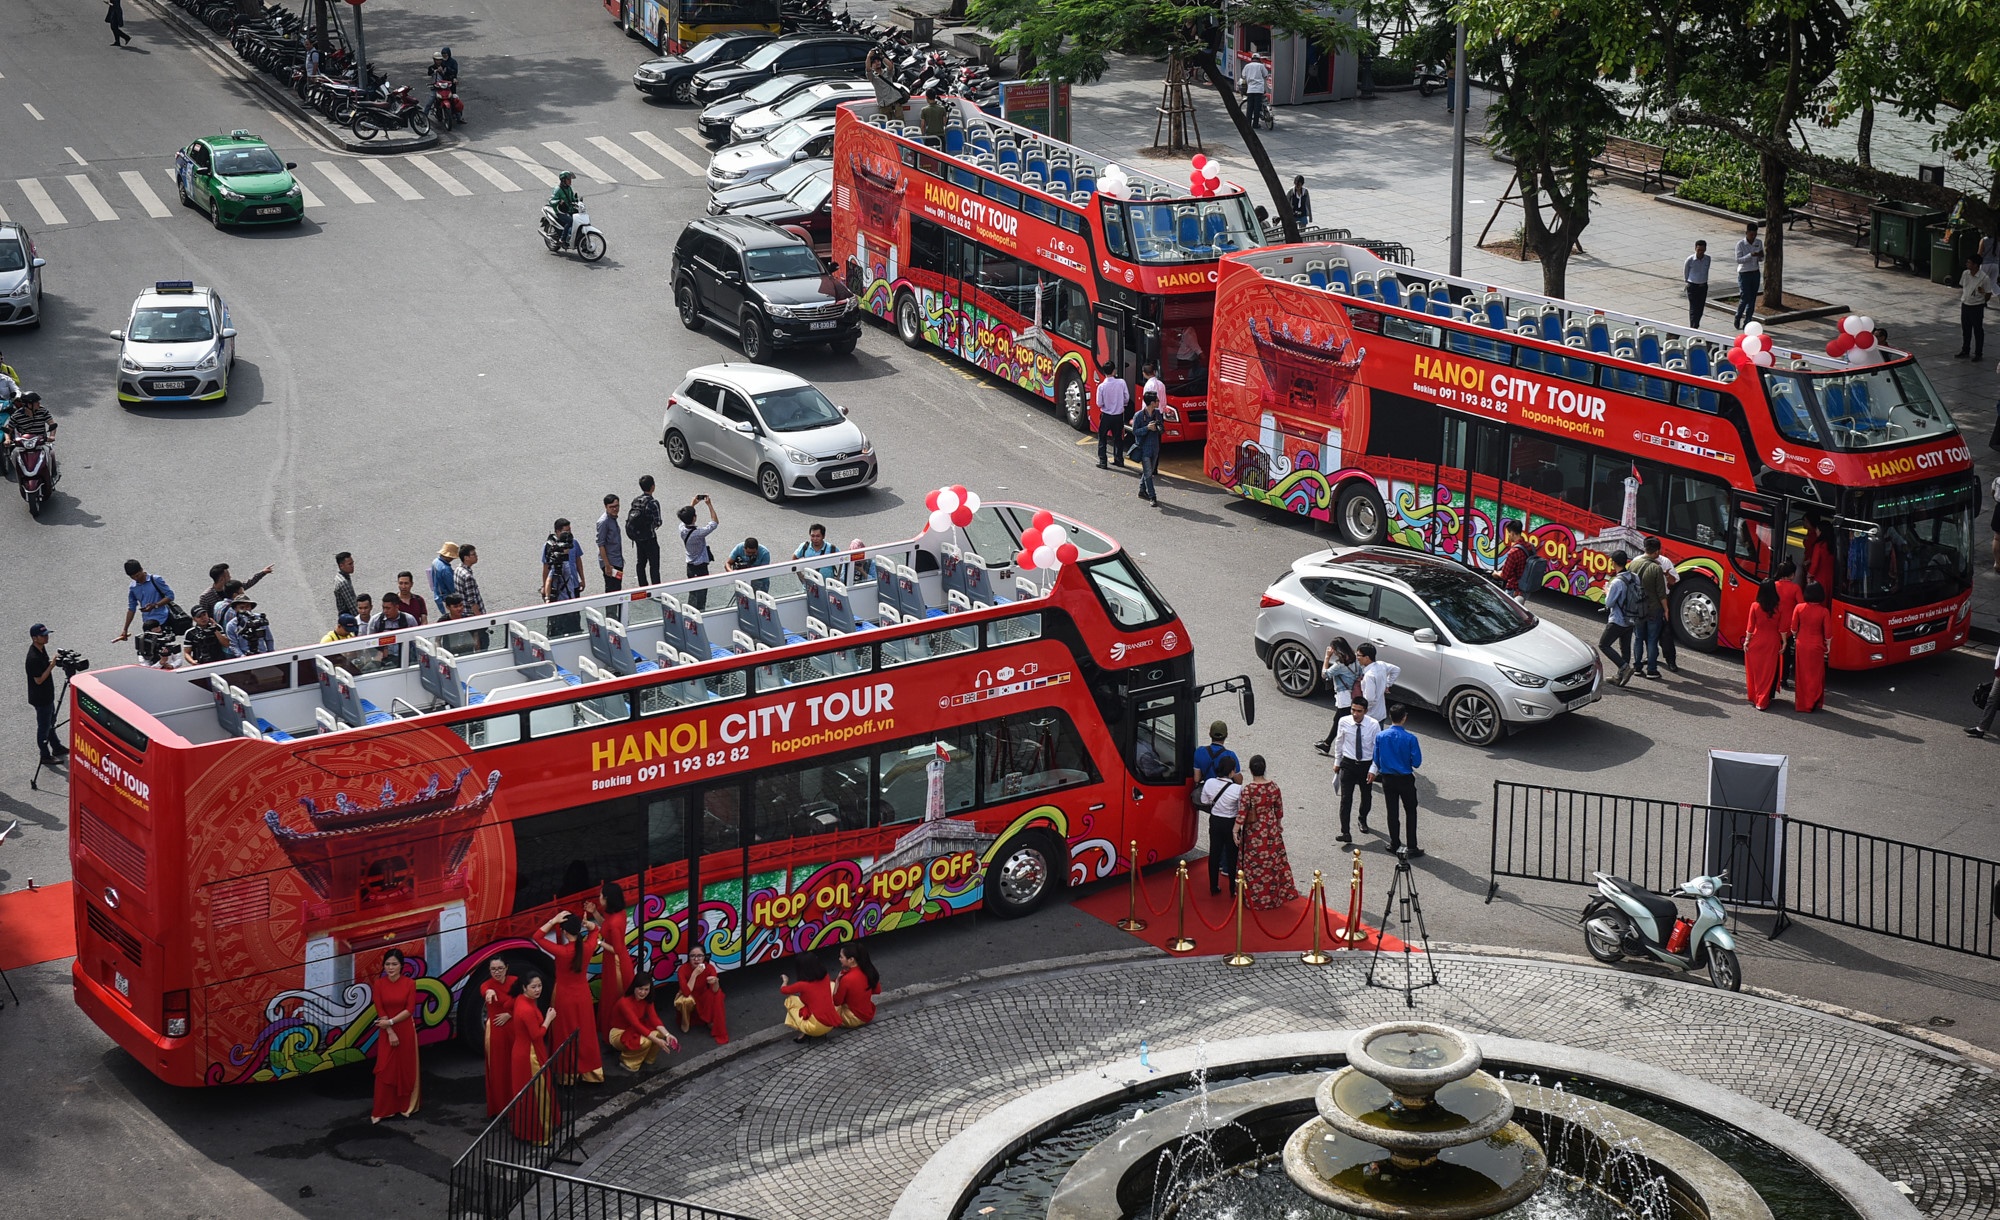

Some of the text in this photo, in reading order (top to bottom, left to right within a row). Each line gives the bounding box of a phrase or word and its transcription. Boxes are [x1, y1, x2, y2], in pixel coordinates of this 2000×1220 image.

[925, 182, 1018, 237] HANOI CITY TOUR
[937, 208, 946, 219] 091
[947, 212, 956, 224] 193
[957, 216, 964, 227] 82
[964, 219, 971, 230] 82
[976, 224, 1017, 249] hopon-hopoff.vn
[1157, 272, 1205, 288] HANOI
[978, 327, 995, 349] HOP
[1016, 345, 1034, 364] HOP
[1036, 355, 1052, 374] OFF
[1413, 382, 1508, 413] Booking 091 193 82 82
[1414, 354, 1606, 421] HANOI CITY TOUR
[1521, 407, 1605, 438] hopon-hopoff.vn
[1867, 458, 1916, 480] HANOI
[1916, 449, 1945, 469] CITY
[1903, 614, 1918, 623] CÔNG
[1125, 640, 1153, 650] TRANSERCO
[592, 683, 894, 772] HANOI CITY TOUR
[771, 718, 894, 753] hopon-hopoff.vn
[74, 732, 149, 801] HANOI CITY TOUR
[592, 746, 749, 791] Booking 091 193 82 82
[755, 892, 806, 927] HOP
[873, 865, 922, 898] HOP
[931, 852, 973, 880] OFF
